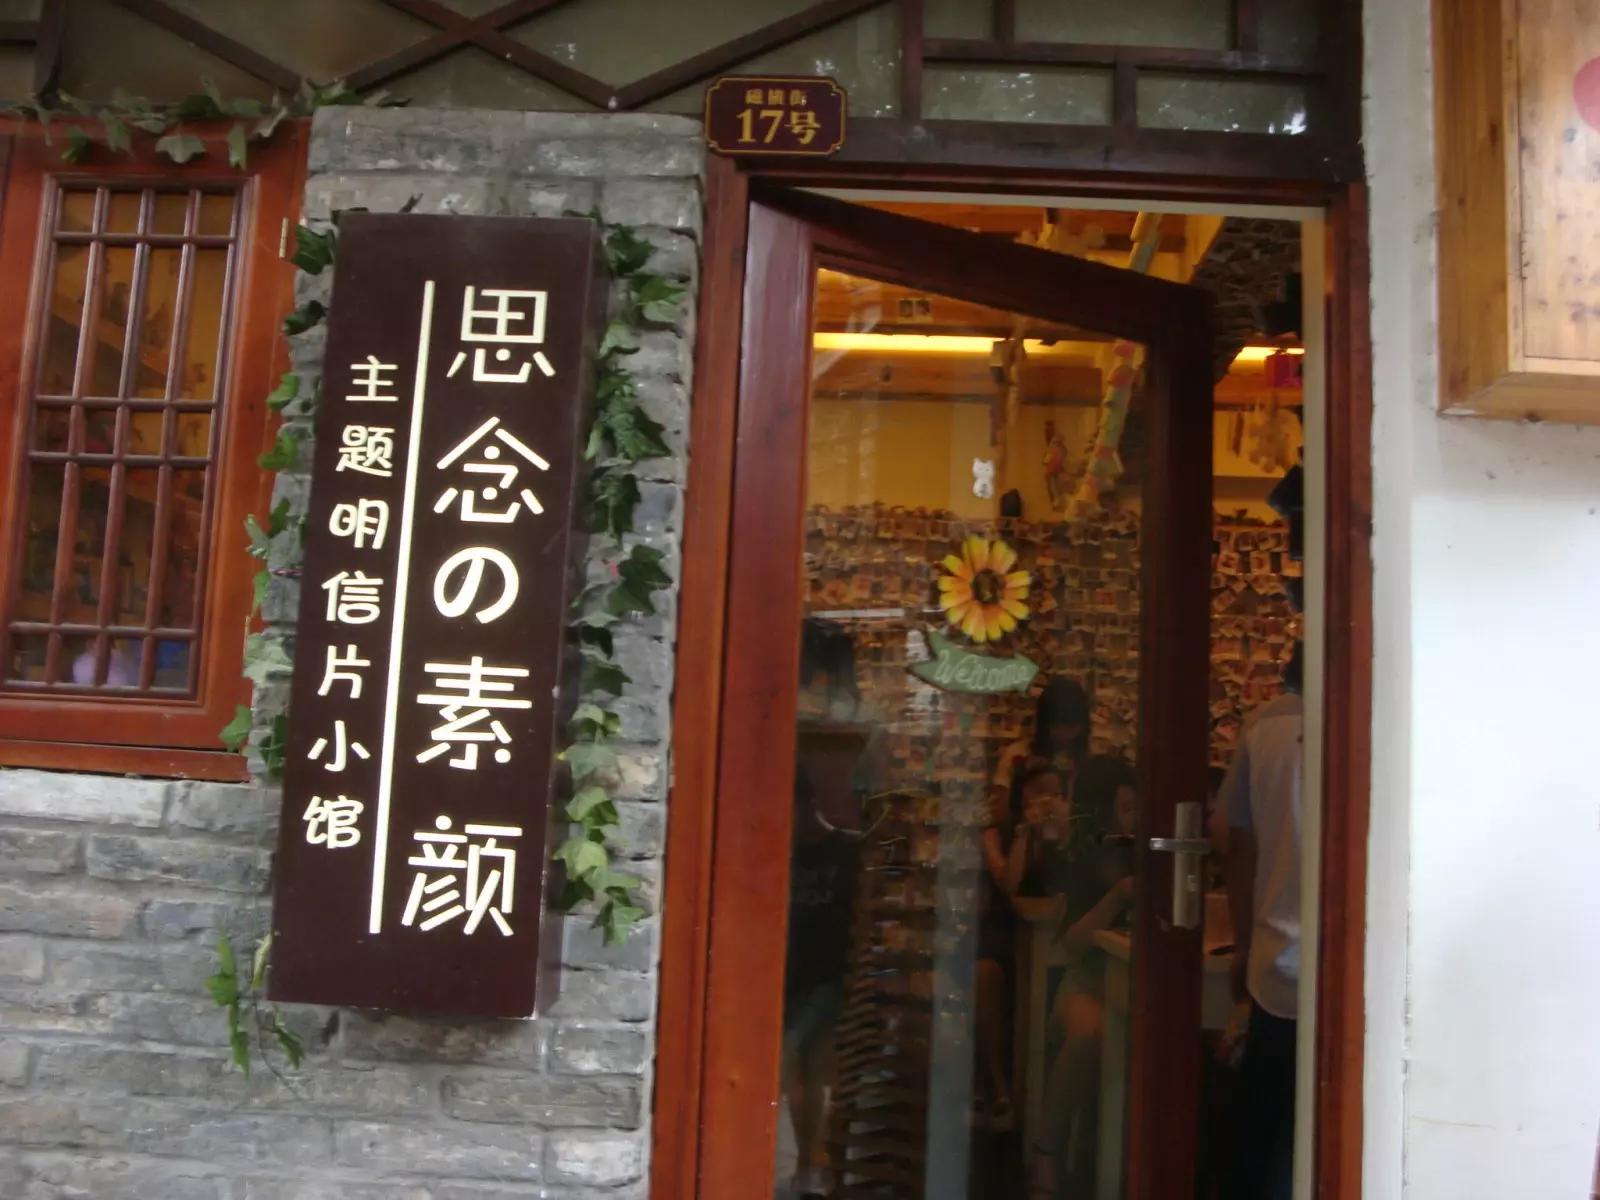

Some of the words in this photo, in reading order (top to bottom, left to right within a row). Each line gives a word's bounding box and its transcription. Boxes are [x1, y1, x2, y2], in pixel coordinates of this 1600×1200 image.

[736, 108, 821, 145] 17号
[302, 354, 399, 849] 主题明信片小馆
[402, 285, 556, 937] 思念の素颜
